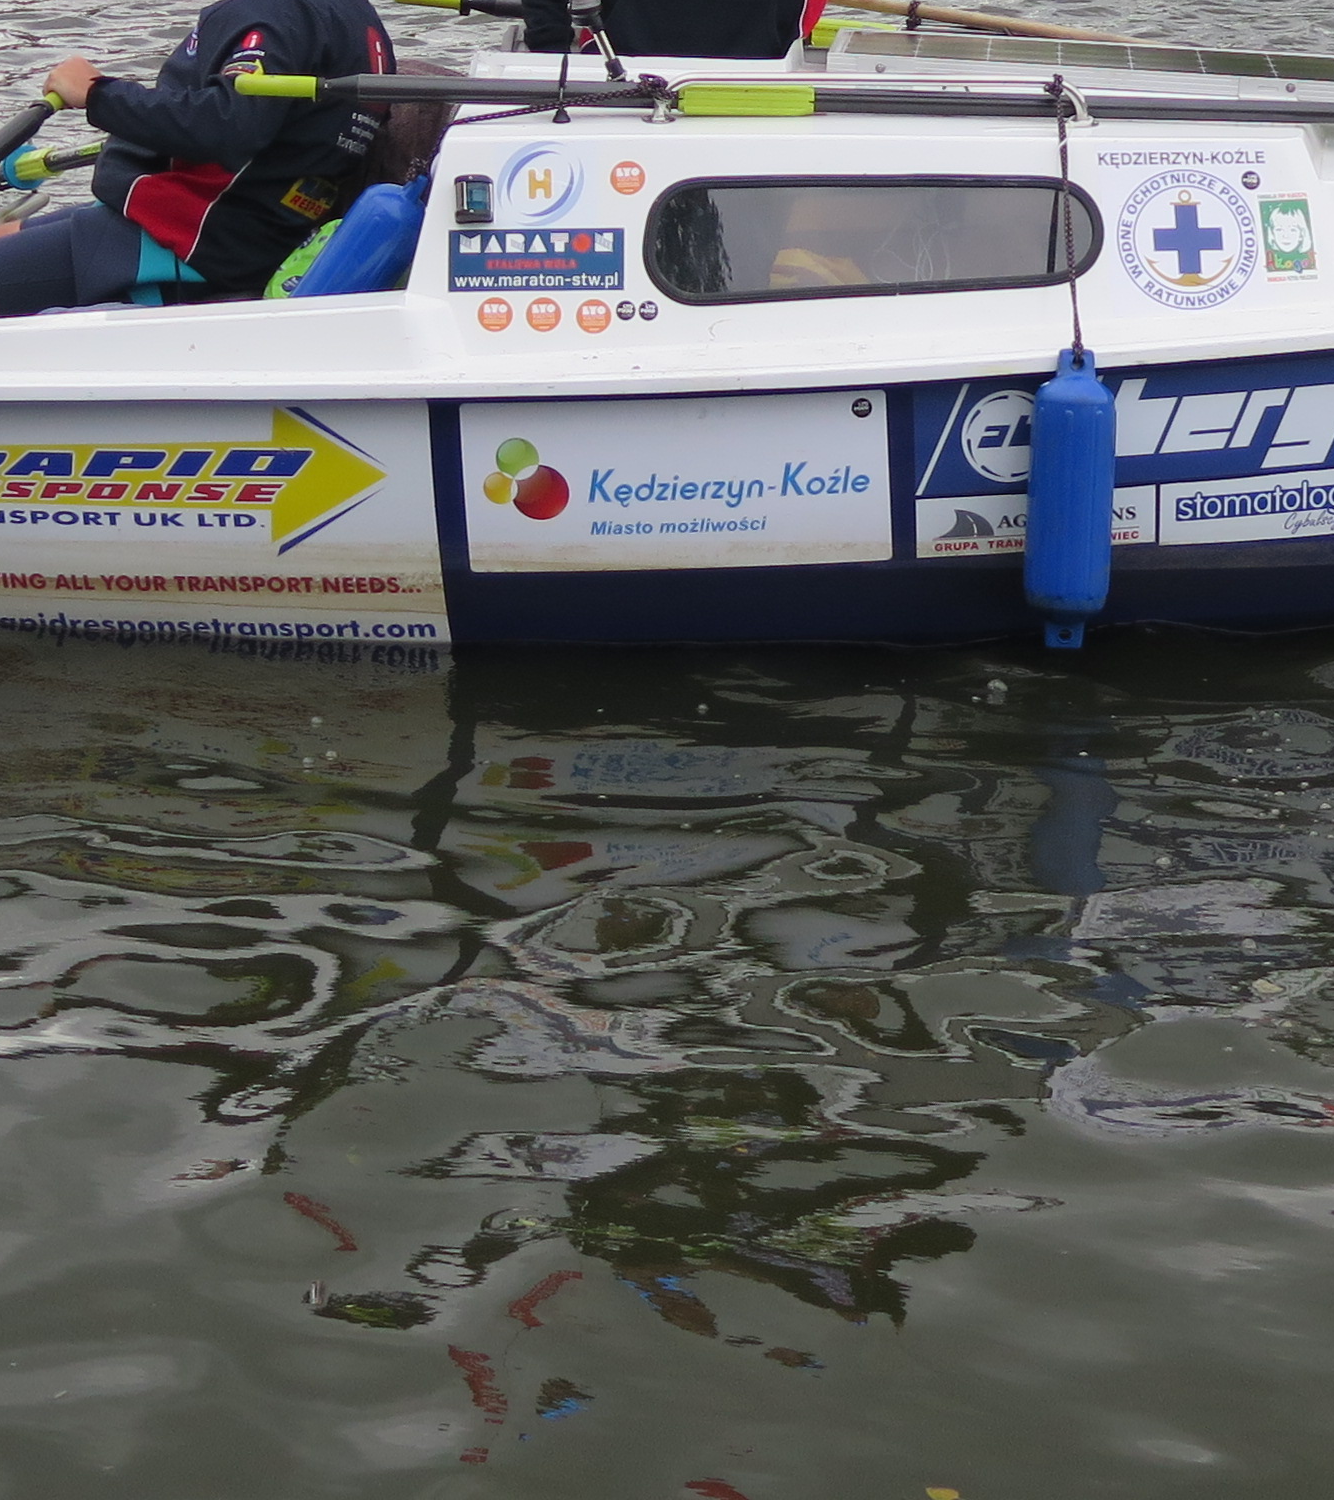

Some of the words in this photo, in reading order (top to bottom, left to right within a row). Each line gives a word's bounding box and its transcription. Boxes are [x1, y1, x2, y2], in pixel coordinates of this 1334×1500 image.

[1097, 149, 1265, 169] KĘDZIERZYN-KOŹLE
[1129, 172, 1217, 216] OCHOTNICZE
[1219, 186, 1256, 280] POGOTOWIE
[459, 231, 615, 254] MARATON
[454, 271, 619, 288] www.maraton-stw.pl
[1143, 280, 1240, 308] RATUNKOWE
[588, 461, 870, 509] Kędzierzyn-Koźle
[134, 512, 185, 527] UK
[198, 513, 265, 528] LTD.
[590, 518, 653, 536] Miasto
[659, 514, 767, 535] możliwości
[934, 542, 980, 553] GRUPA
[988, 539, 1026, 550] TRAN
[55, 574, 95, 591] ALL
[100, 574, 166, 592] YOUR
[173, 576, 313, 594] TRANSPORT
[323, 577, 422, 594] NEEDS...
